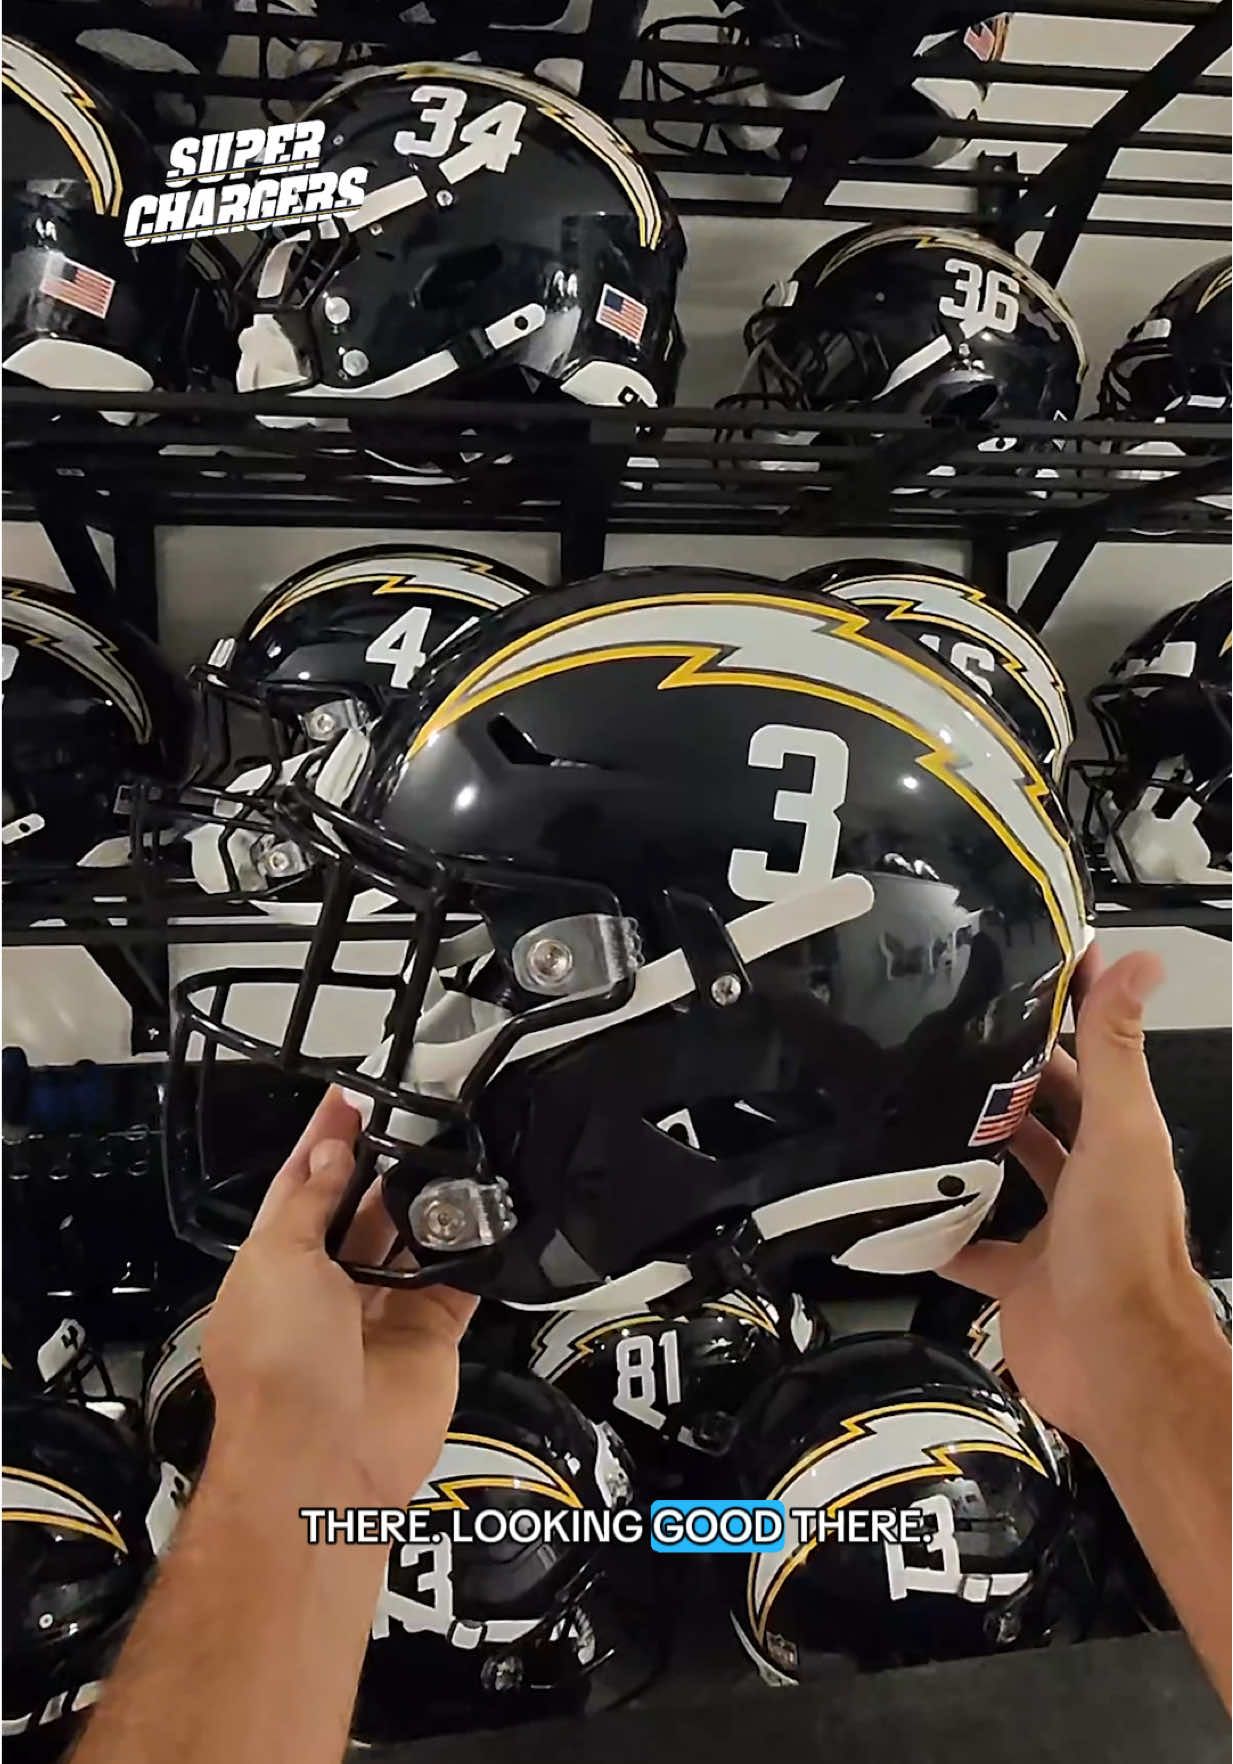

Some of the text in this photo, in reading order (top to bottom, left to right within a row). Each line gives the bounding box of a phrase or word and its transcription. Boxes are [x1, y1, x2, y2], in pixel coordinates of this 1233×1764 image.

[393, 85, 527, 174] 34
[939, 258, 1020, 334] 36
[365, 606, 432, 689] 4
[727, 723, 849, 902] 3
[614, 1329, 682, 1411] 81
